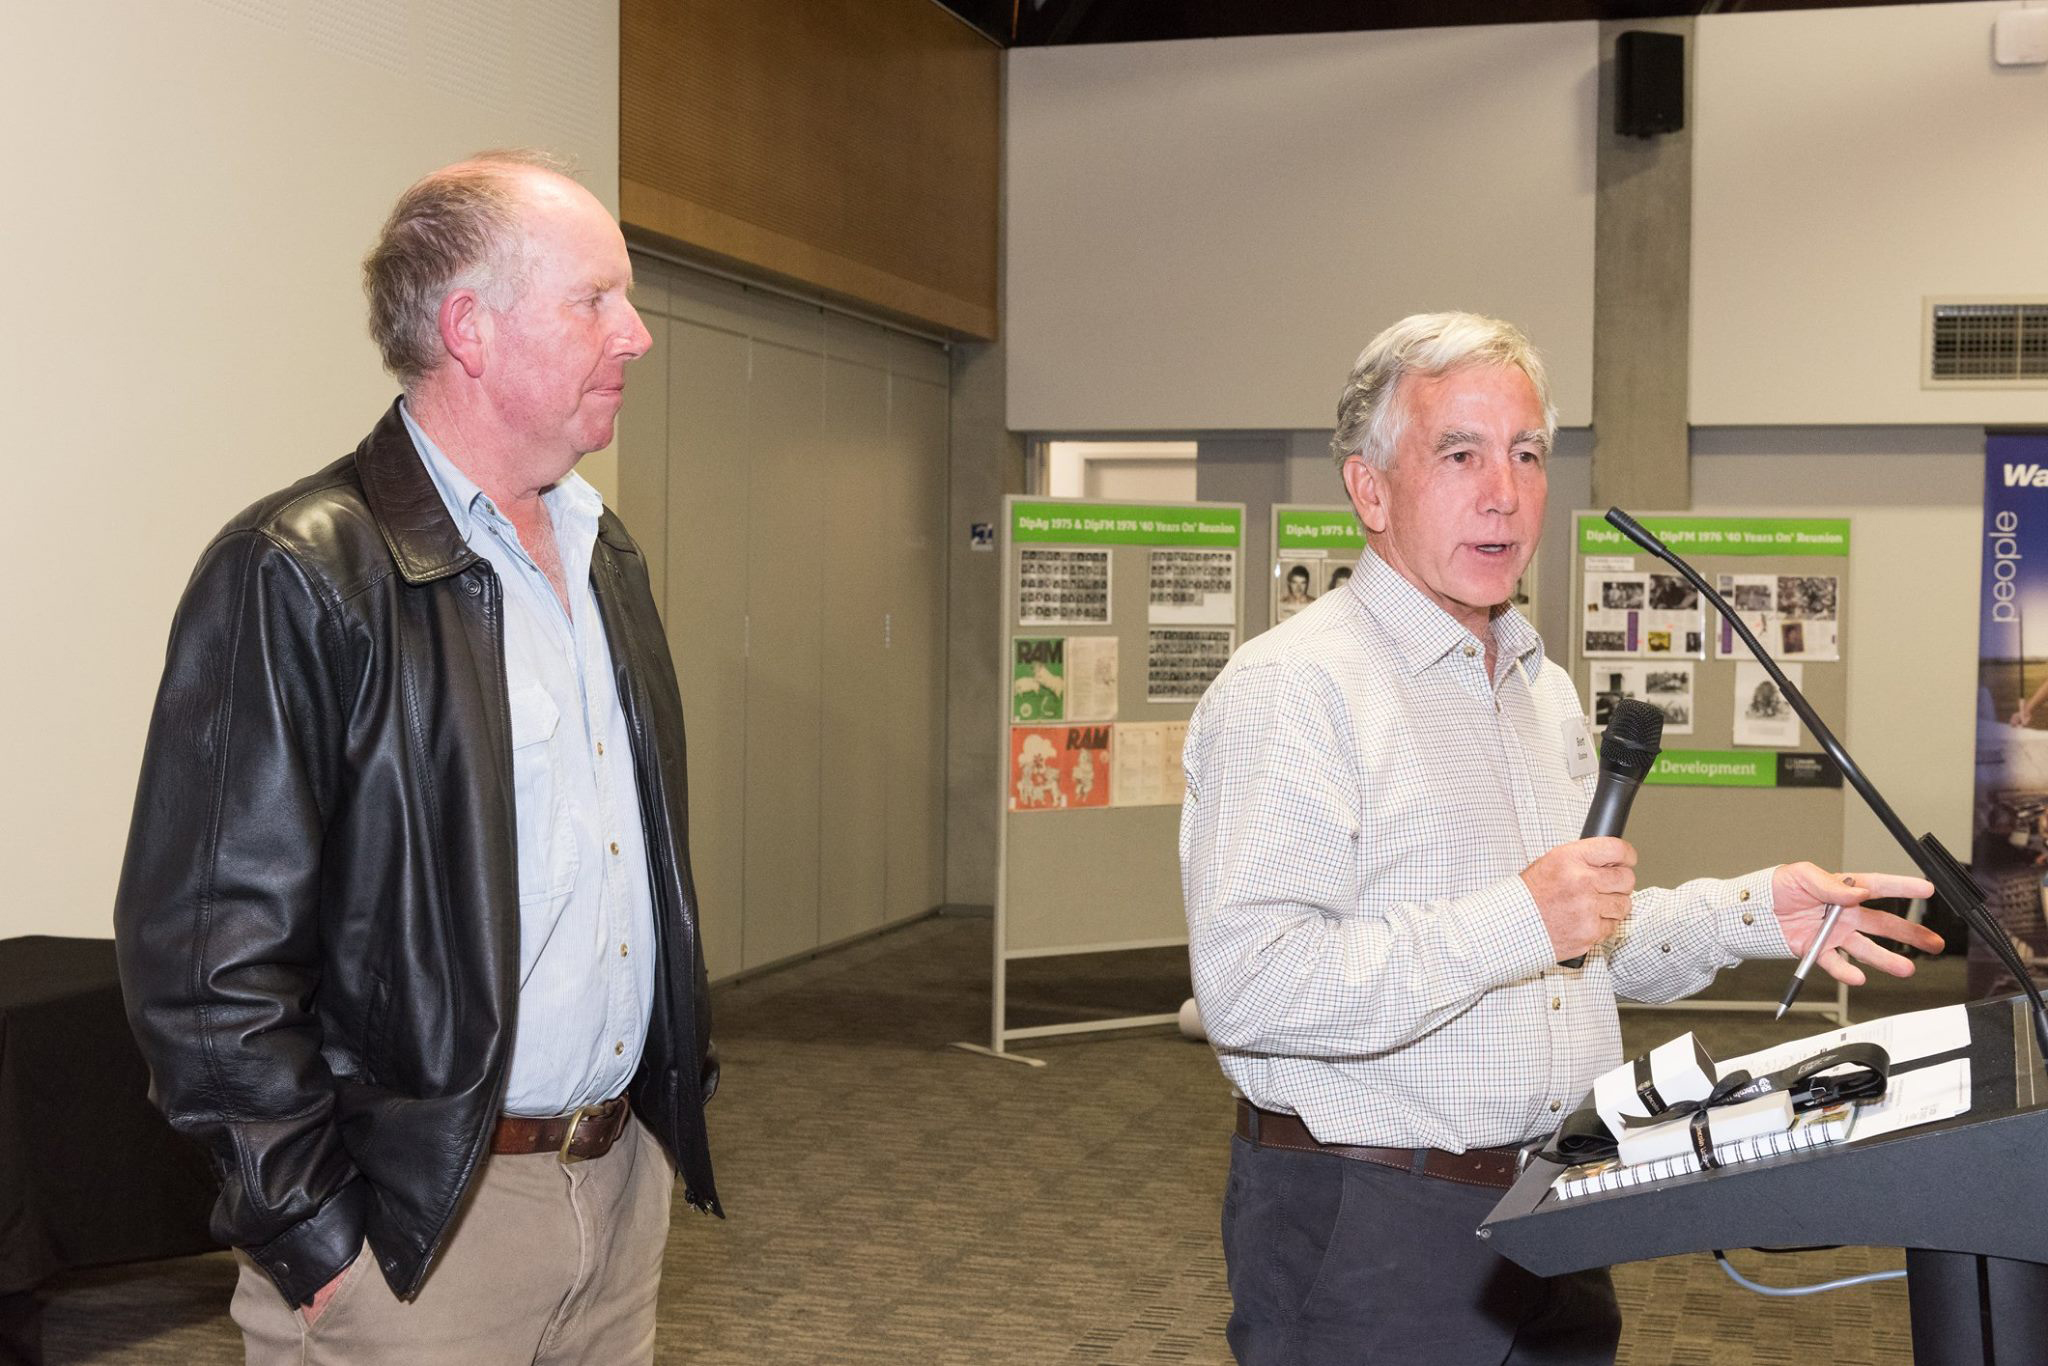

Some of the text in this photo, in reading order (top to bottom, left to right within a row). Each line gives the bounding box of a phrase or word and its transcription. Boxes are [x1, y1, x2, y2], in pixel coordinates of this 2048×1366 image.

[1074, 519, 1083, 530] &
[1286, 524, 1319, 537] DipAg
[1321, 525, 1344, 536] 1975
[1345, 526, 1354, 536] &
[1586, 530, 1620, 543] DipAg
[1743, 532, 1773, 543] Years
[1795, 532, 1843, 543] Reunion
[1988, 510, 2022, 622] people
[1017, 640, 1063, 664] RAM
[1066, 727, 1110, 751] RAM
[1661, 760, 1757, 776] Development
